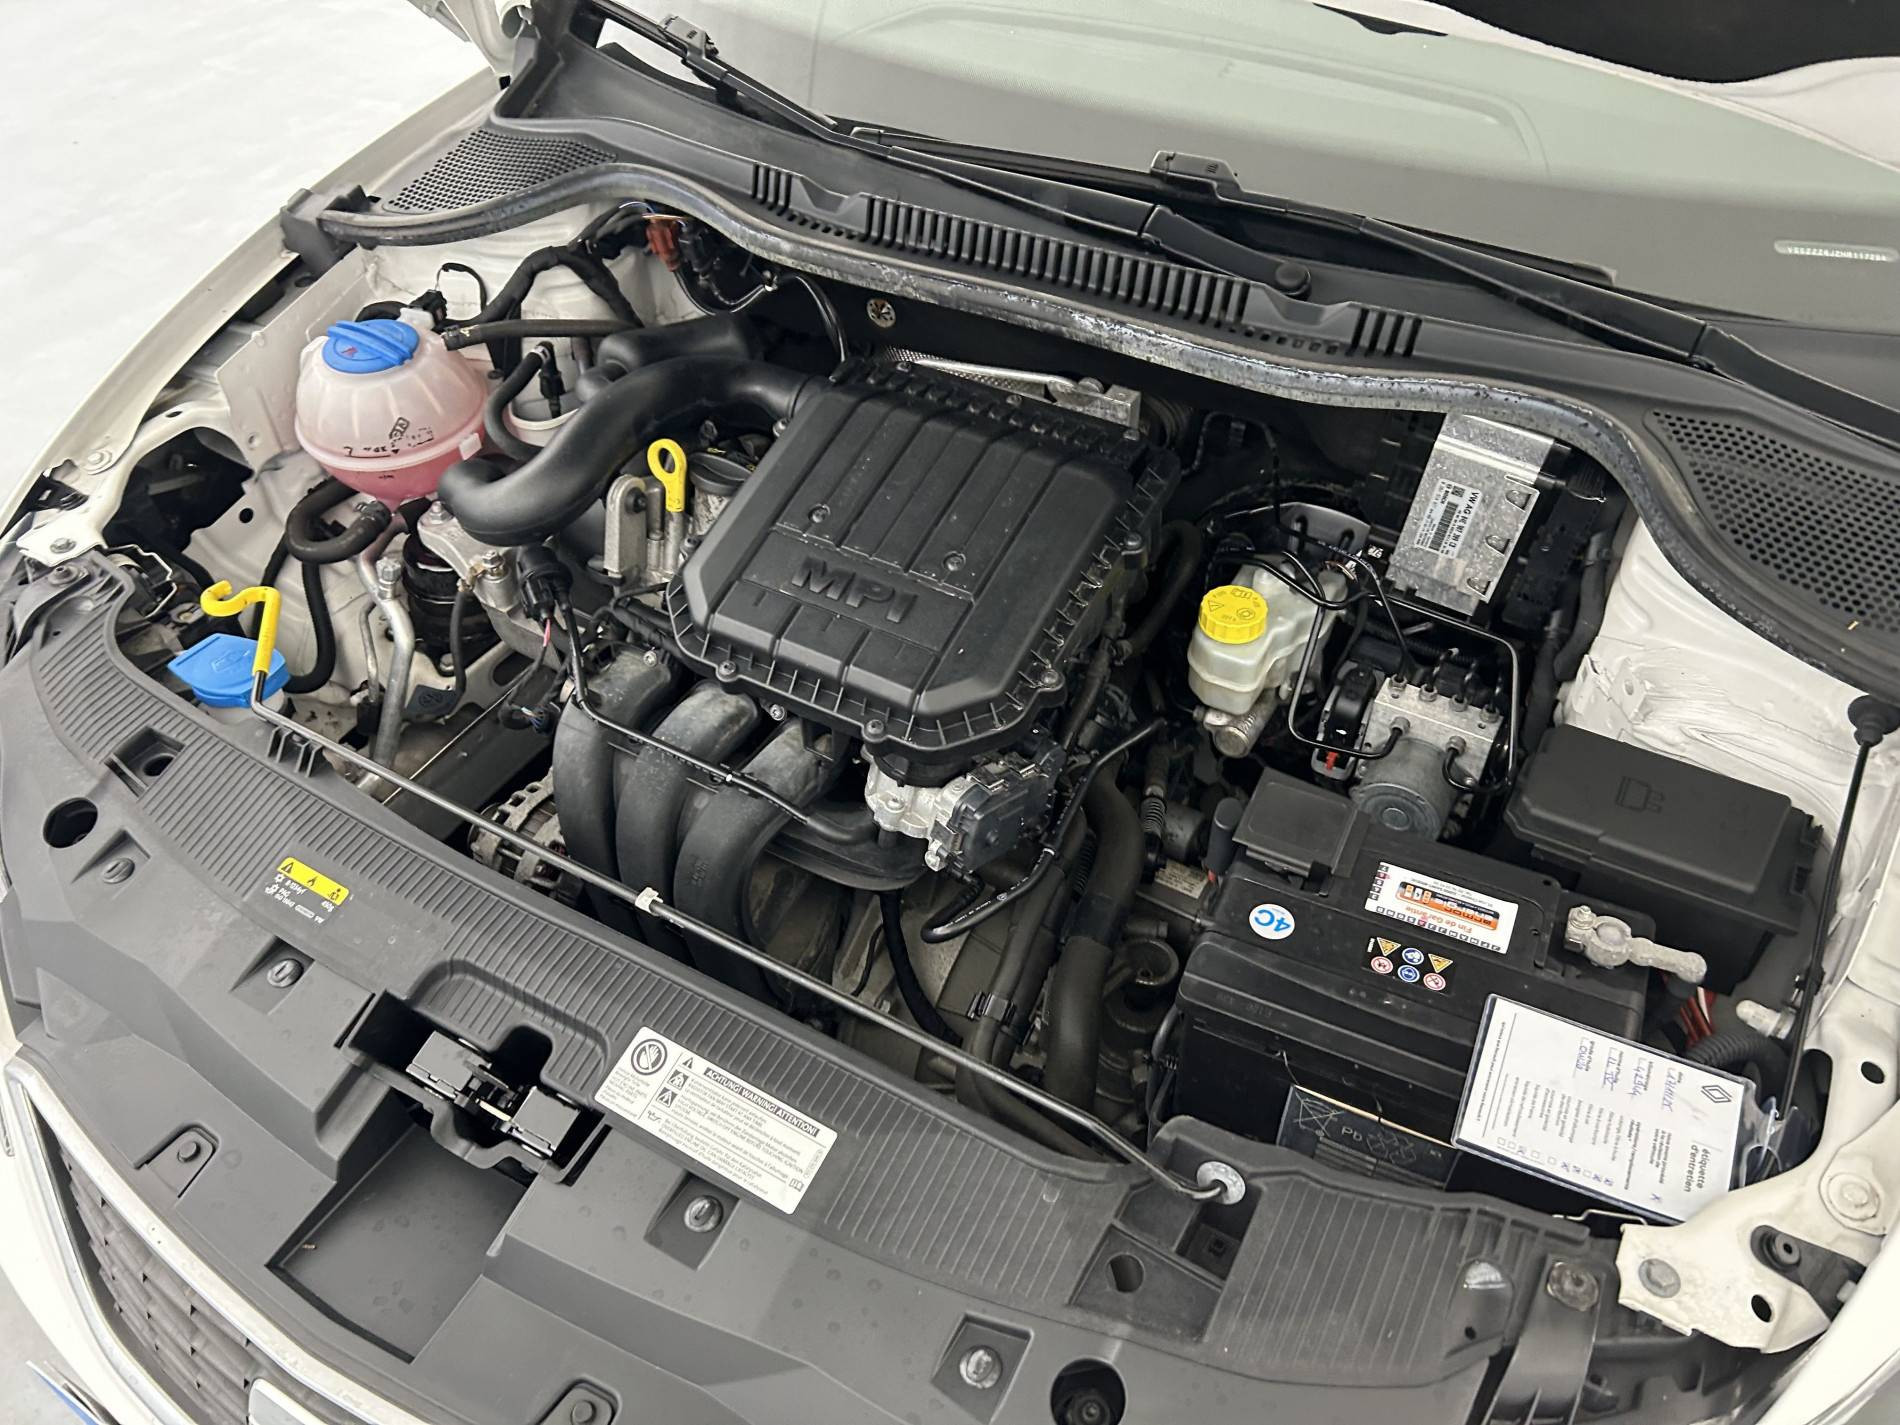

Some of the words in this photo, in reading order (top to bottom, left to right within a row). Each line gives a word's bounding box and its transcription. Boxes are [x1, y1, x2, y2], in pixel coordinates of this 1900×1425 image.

[1468, 492, 1479, 503] VW
[1463, 504, 1473, 514] AG
[791, 556, 918, 623] MPI
[1254, 909, 1291, 932] 4C
[1444, 918, 1456, 928] de
[1456, 923, 1472, 933] Fin
[705, 1070, 741, 1093] ACHTUNG!
[739, 1089, 777, 1113] WARNING!
[774, 1109, 817, 1136] ATTENTION!
[1341, 1126, 1363, 1142] Pb
[1684, 1144, 1699, 1193] d'entretien
[1697, 1148, 1710, 1189] étiquette
